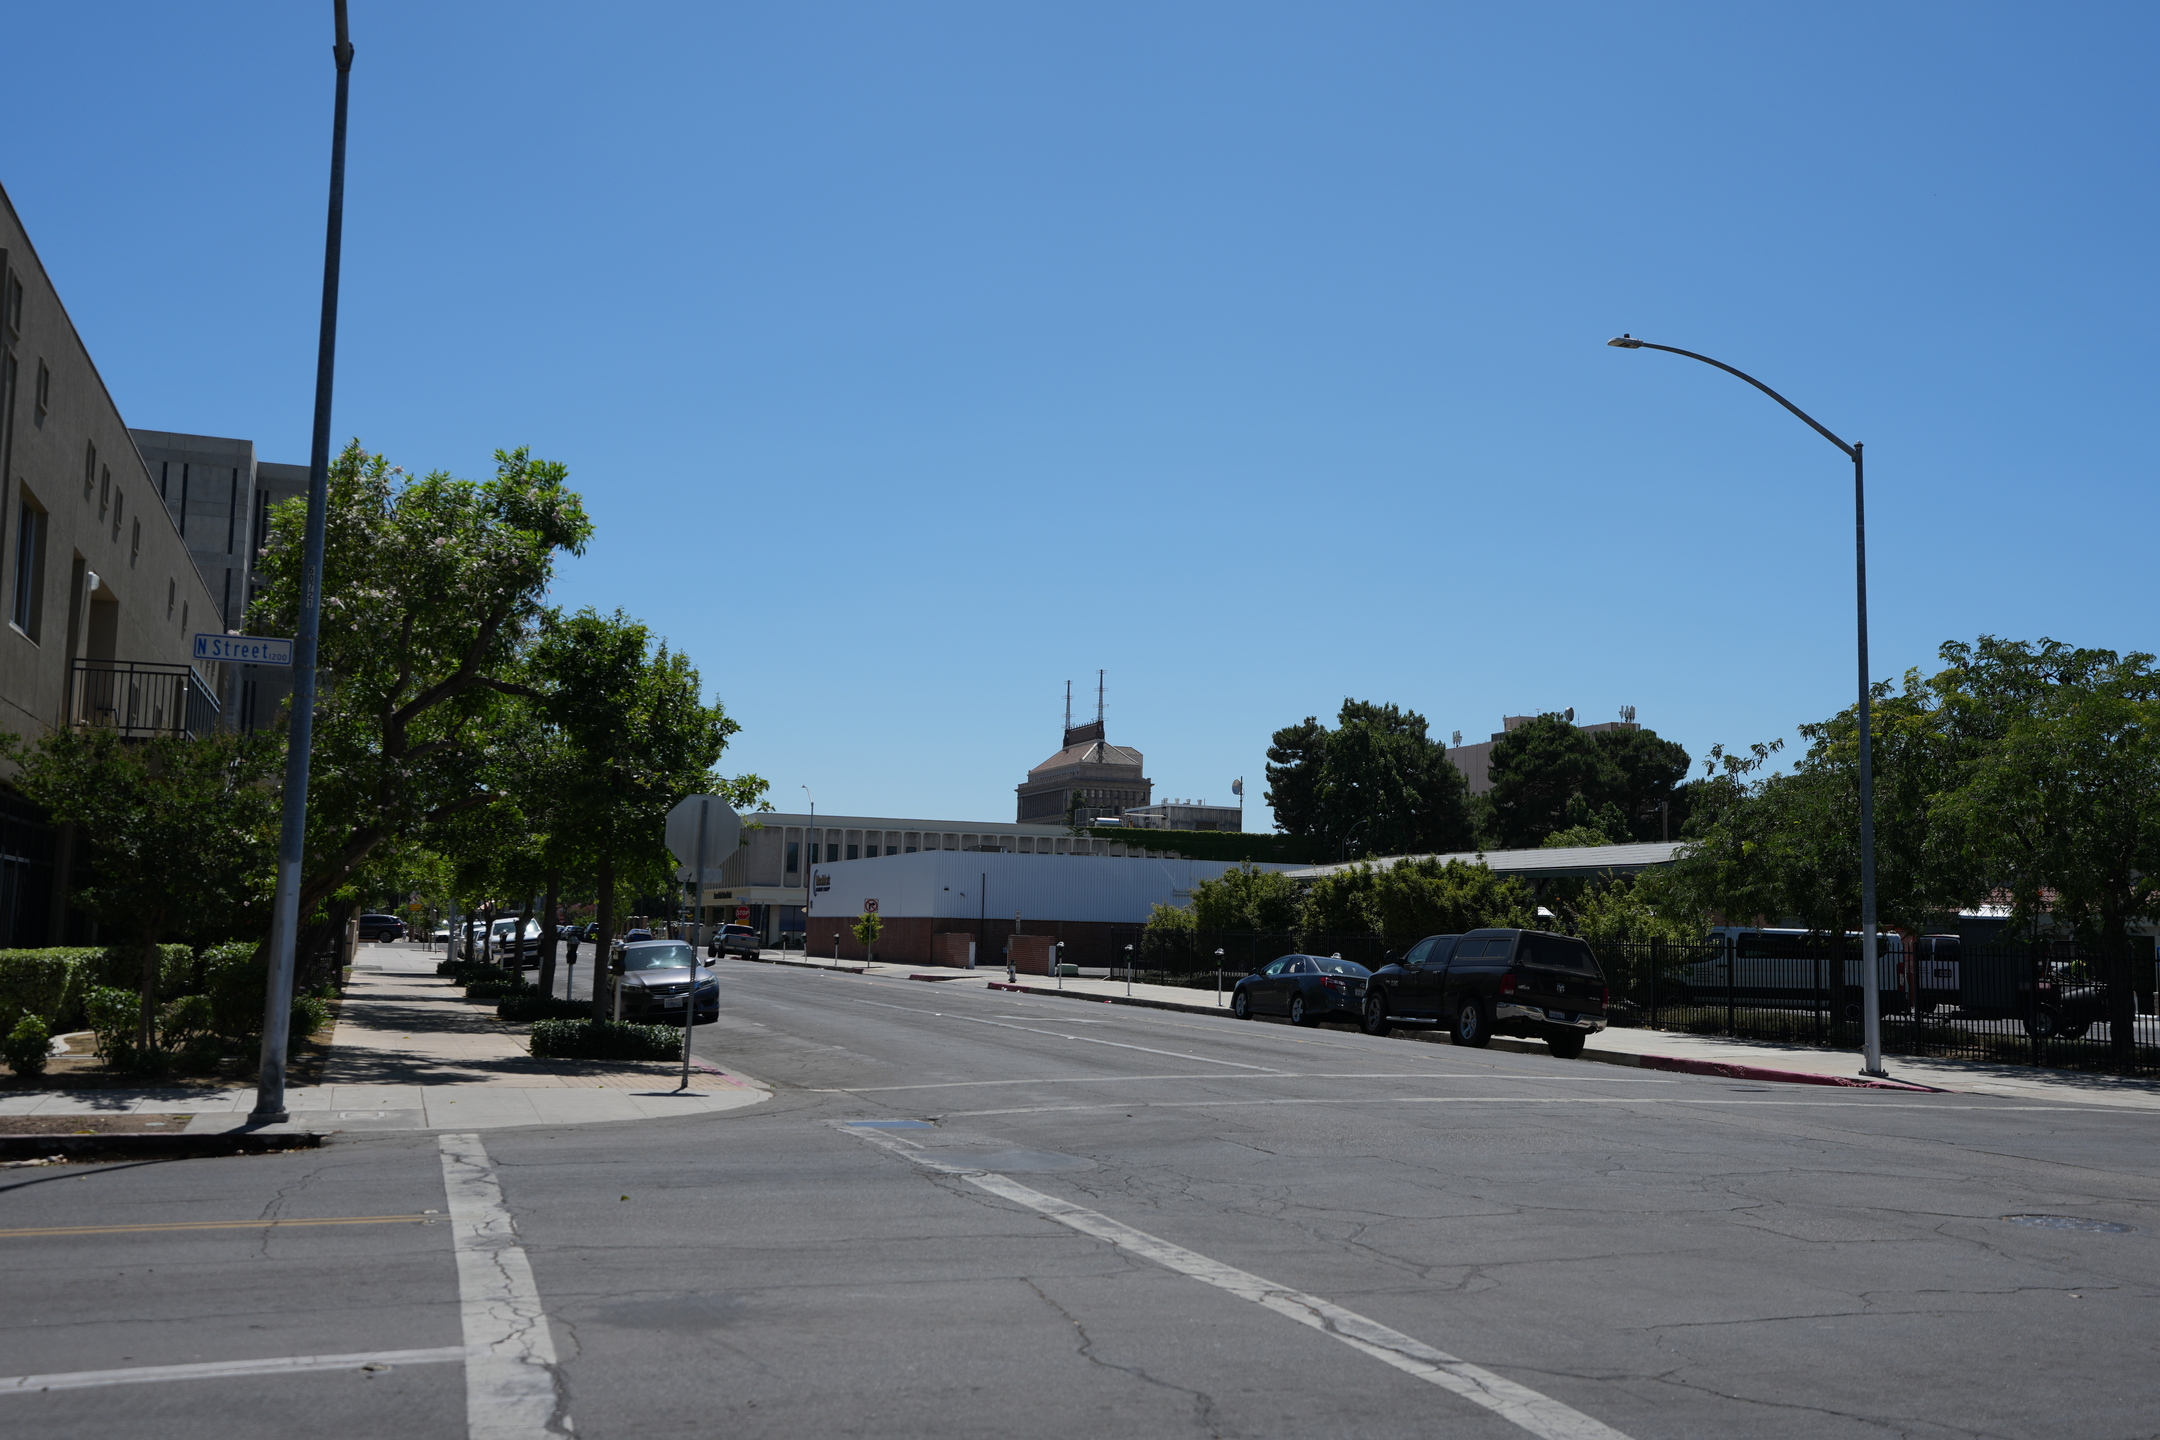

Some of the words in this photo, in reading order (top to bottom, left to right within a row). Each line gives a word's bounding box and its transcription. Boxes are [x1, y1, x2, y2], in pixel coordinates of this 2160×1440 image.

[197, 638, 207, 655] N
[212, 639, 268, 659] Street
[268, 653, 287, 662] 1200
